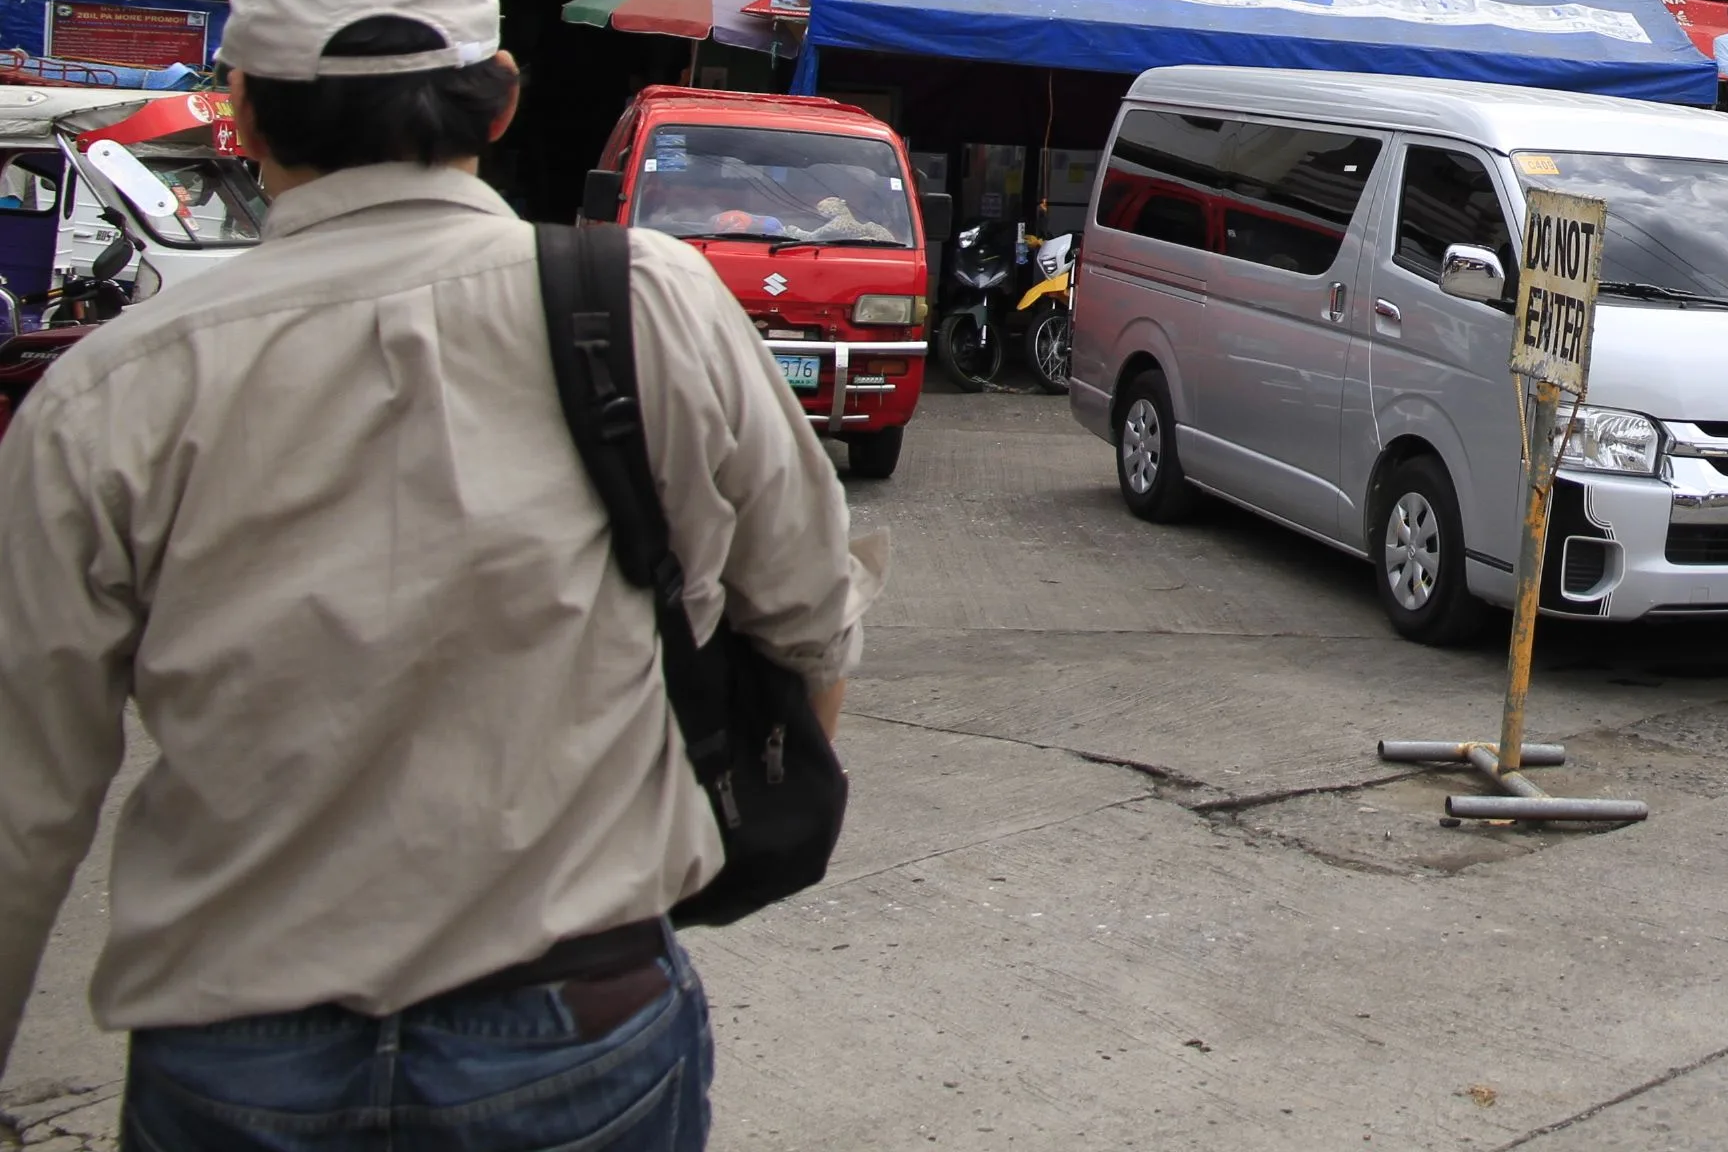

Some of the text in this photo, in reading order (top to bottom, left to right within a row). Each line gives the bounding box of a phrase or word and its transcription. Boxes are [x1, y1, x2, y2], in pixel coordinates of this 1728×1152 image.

[1526, 212, 1594, 283] DO NOT
[1524, 286, 1586, 364] ENTER
